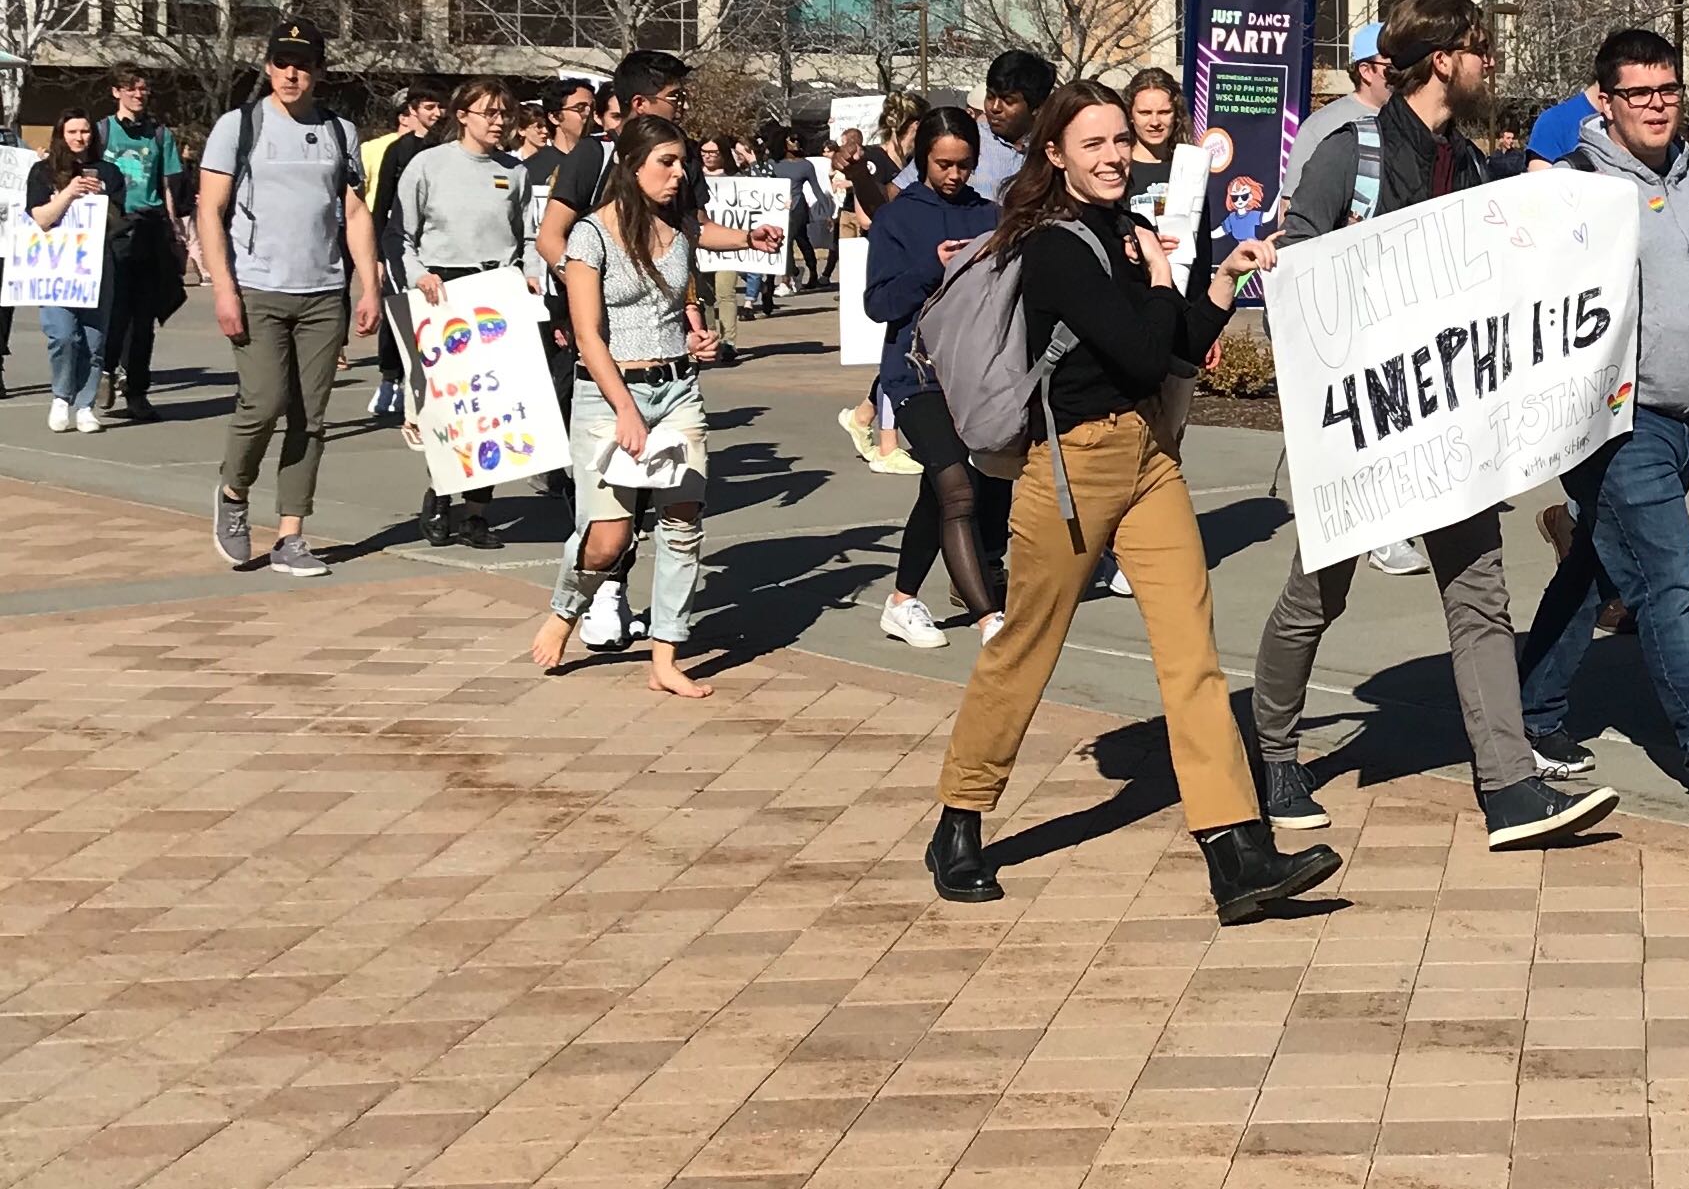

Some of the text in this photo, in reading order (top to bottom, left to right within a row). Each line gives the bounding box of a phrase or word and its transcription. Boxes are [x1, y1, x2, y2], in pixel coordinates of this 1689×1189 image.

[1211, 9, 1291, 28] JUST DANCE
[1210, 27, 1288, 55] PARTY
[1215, 93, 1278, 104] WSC BALLROOM
[1222, 83, 1232, 91] TO
[1243, 84, 1255, 92] PM
[1256, 85, 1263, 93] IN
[1264, 86, 1279, 94] THE
[1214, 104, 1277, 115] BYU ID REQUIRED
[267, 141, 334, 160] DVIS
[725, 180, 786, 212] JESUS
[12, 232, 92, 276] LOVE
[1295, 198, 1493, 370] UNTIL
[415, 306, 508, 368] GOD
[1532, 286, 1611, 367] 1:15
[453, 397, 481, 415] ME
[452, 430, 535, 478] YOU
